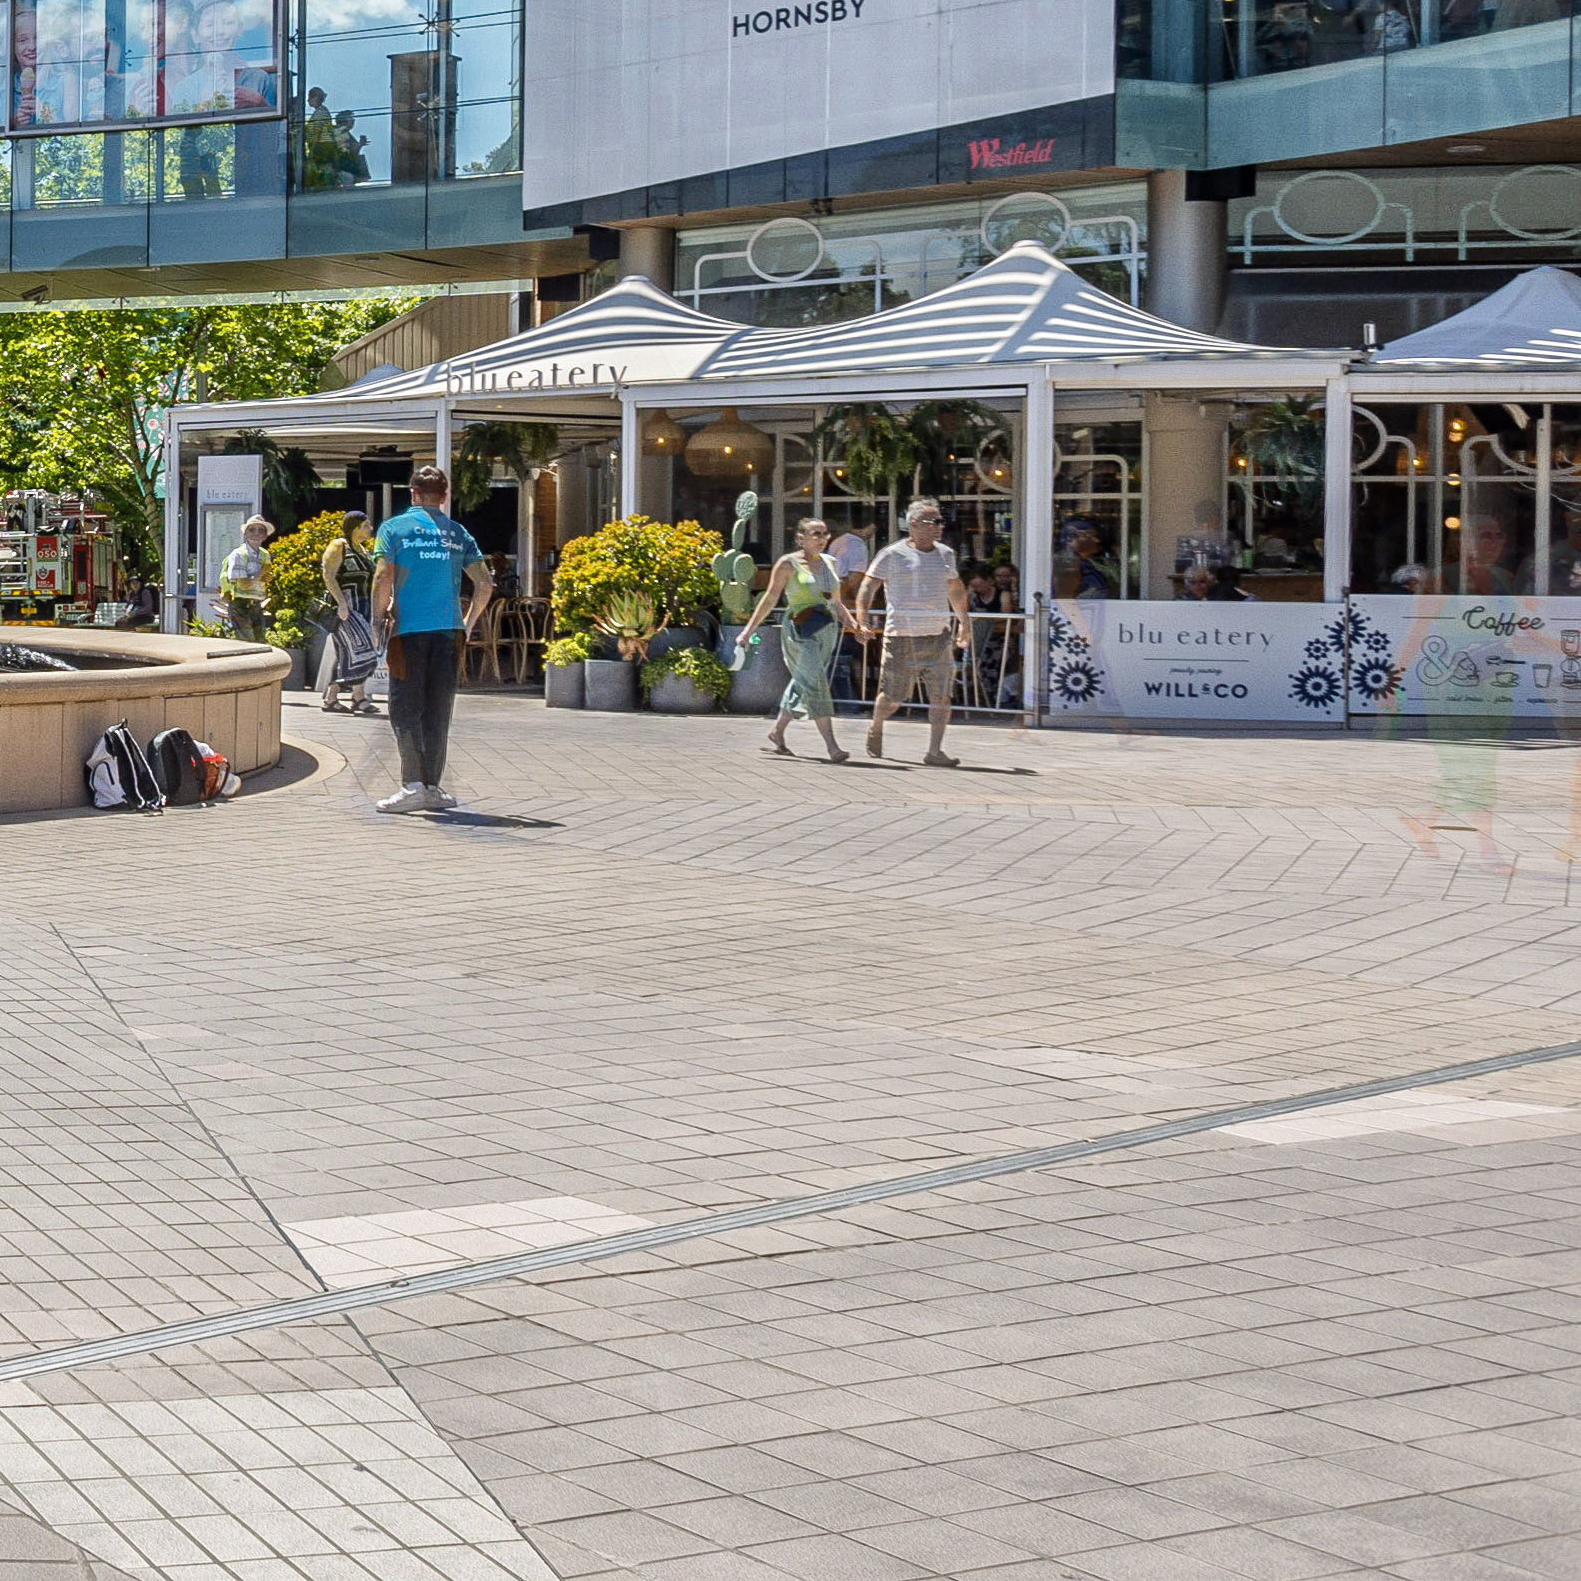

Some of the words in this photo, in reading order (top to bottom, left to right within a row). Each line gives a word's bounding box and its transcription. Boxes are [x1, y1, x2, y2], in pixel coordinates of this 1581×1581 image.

[966, 136, 1057, 173] Westfield
[446, 361, 498, 395] blu
[507, 363, 628, 399] eatery
[414, 526, 447, 536] Create
[419, 551, 451, 561] today!
[1462, 605, 1546, 636] Coffee
[1119, 623, 1163, 644] blu
[1177, 628, 1274, 652] eatery
